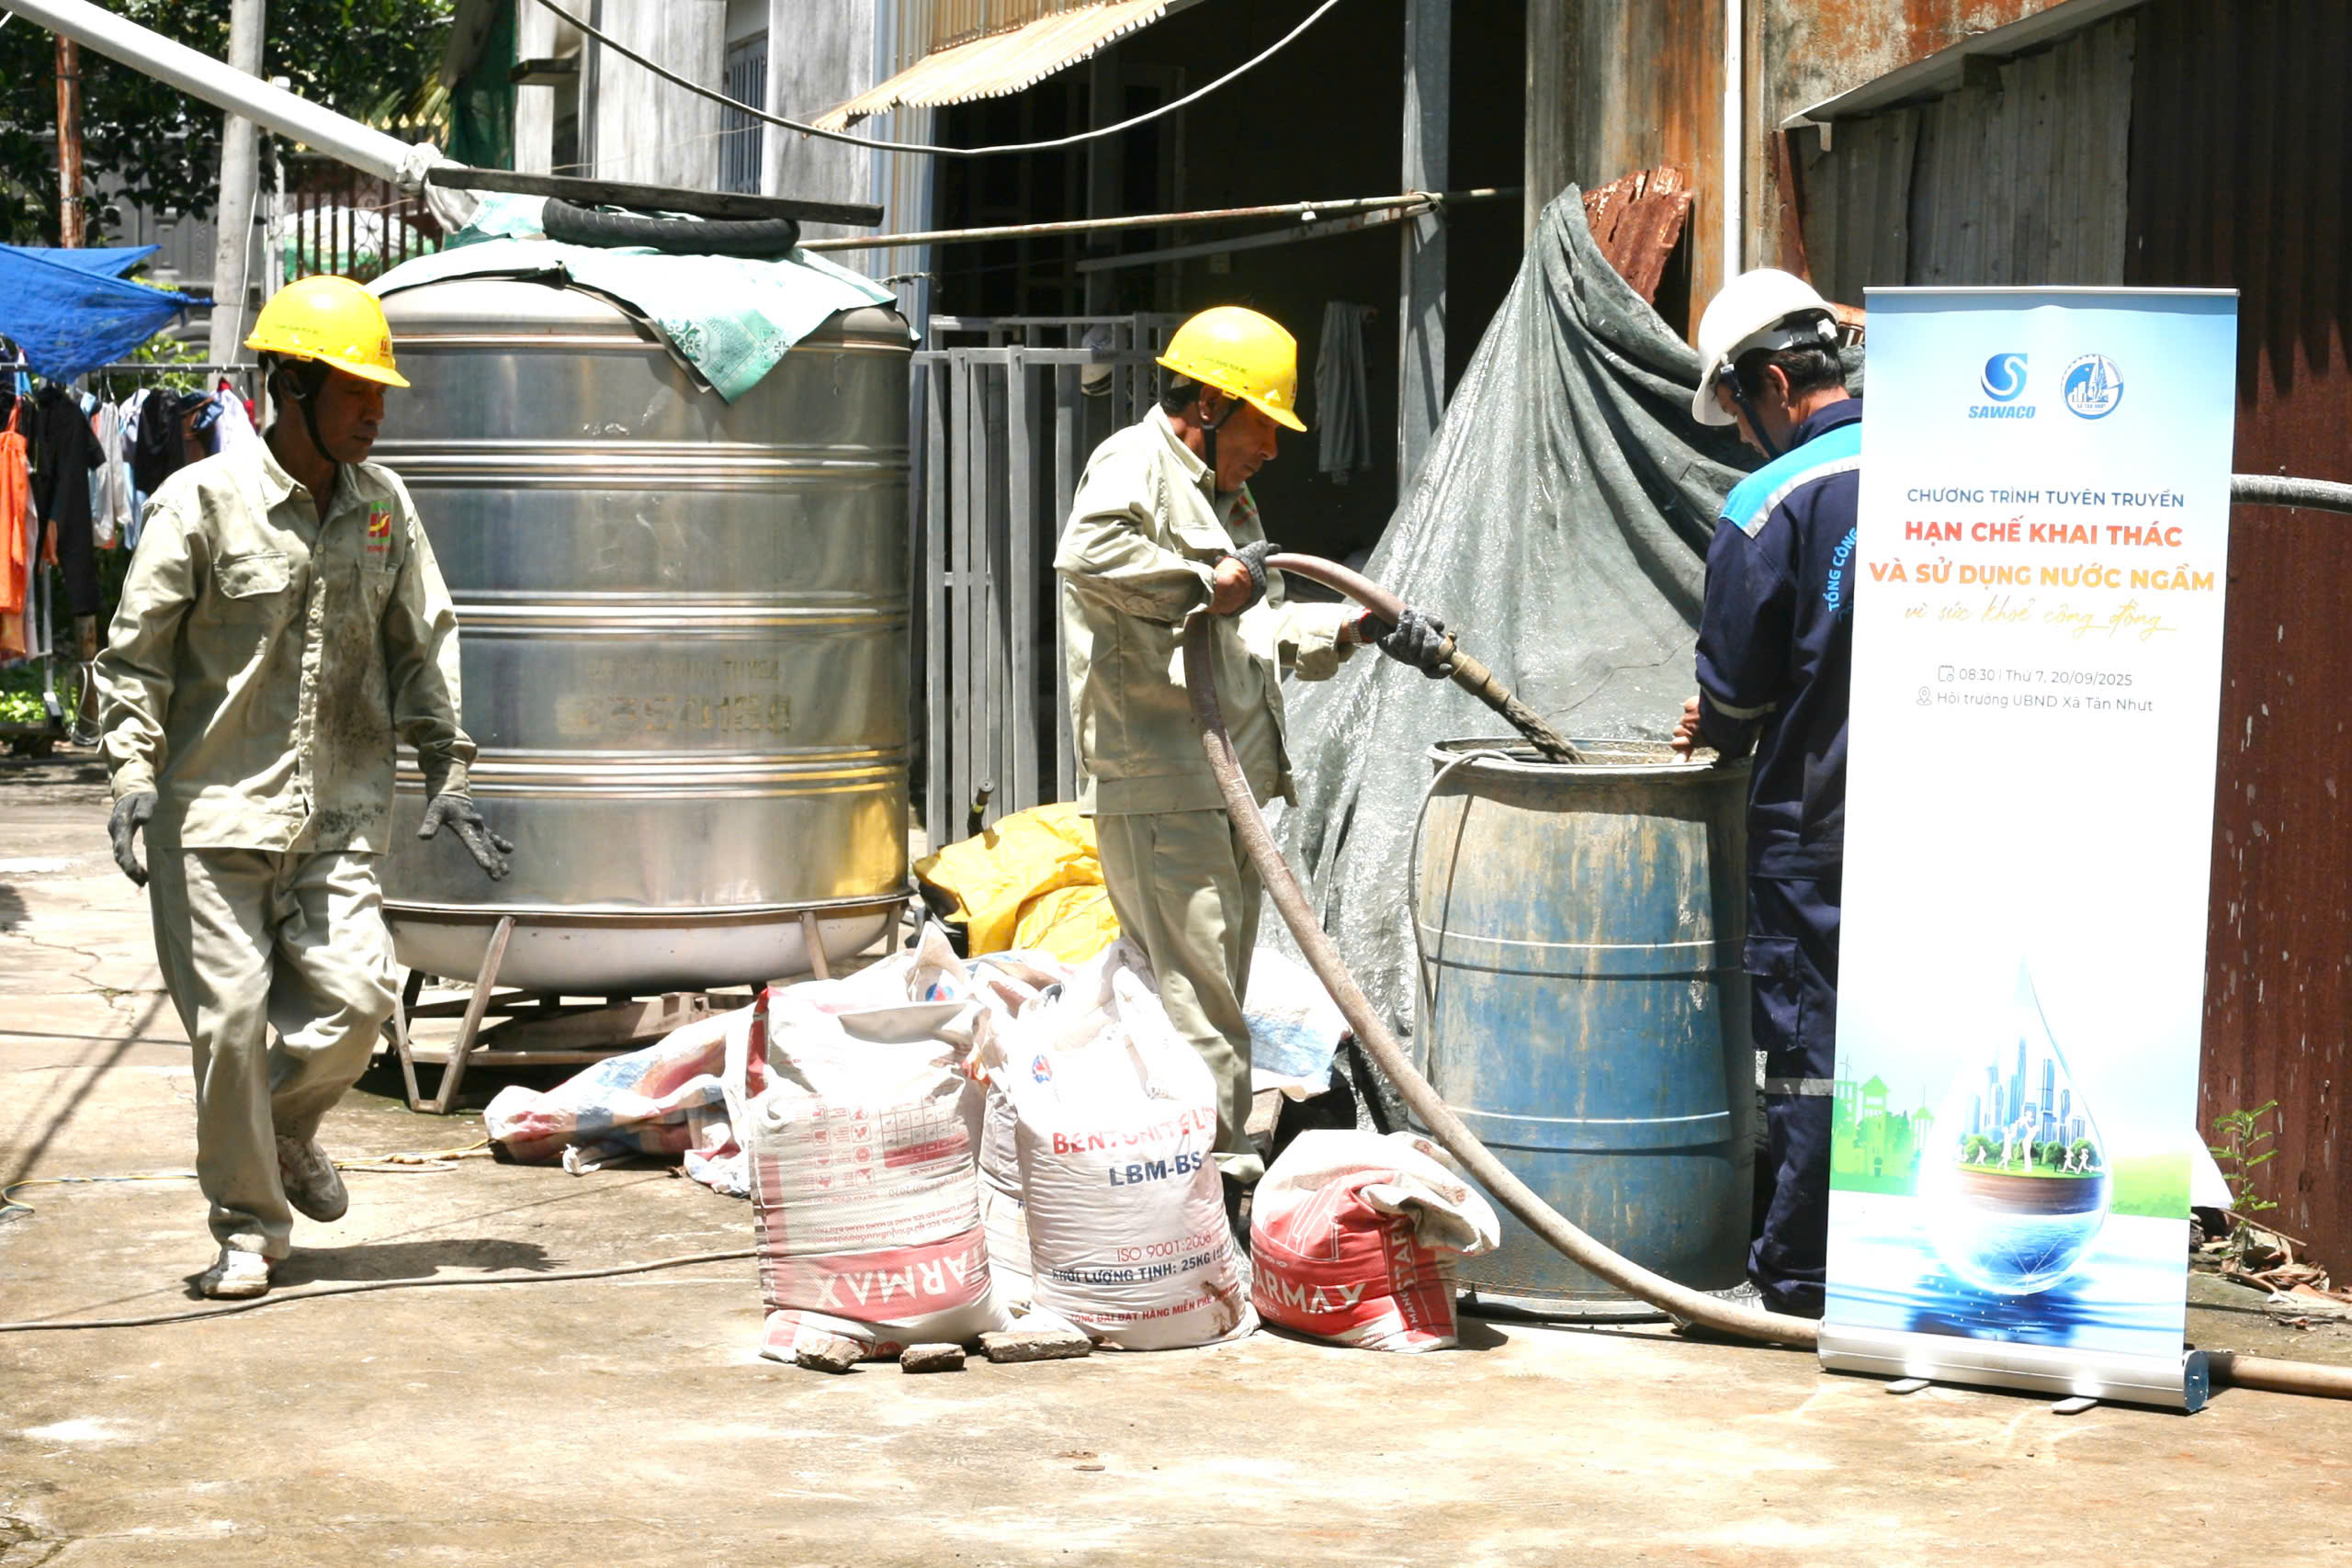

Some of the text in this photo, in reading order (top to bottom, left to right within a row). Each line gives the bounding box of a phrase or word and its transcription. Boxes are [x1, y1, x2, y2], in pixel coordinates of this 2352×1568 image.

[1968, 405, 2037, 419] SAWACO
[1907, 487, 1984, 503] CHƯƠNG
[1989, 487, 2040, 503] TRÌNH
[2045, 488, 2106, 505] TUYÊN
[1905, 515, 2183, 547] HẠN CHẾ KHAI THÁC
[1869, 556, 2215, 592] VÀ SỬ DỤNG NƯỚC NGẦM
[1958, 668, 1996, 682] 08:30
[2051, 671, 2133, 687] 20/09/2025
[2013, 694, 2058, 708] UBND
[1109, 1151, 1203, 1187] LBM-BS
[1116, 1247, 1142, 1262] ISO
[1085, 1267, 1134, 1285] LƯỢNG
[1139, 1263, 1177, 1281] TỊNH:
[1182, 1252, 1211, 1272] 25KG
[1142, 1307, 1170, 1321] HÀNG
